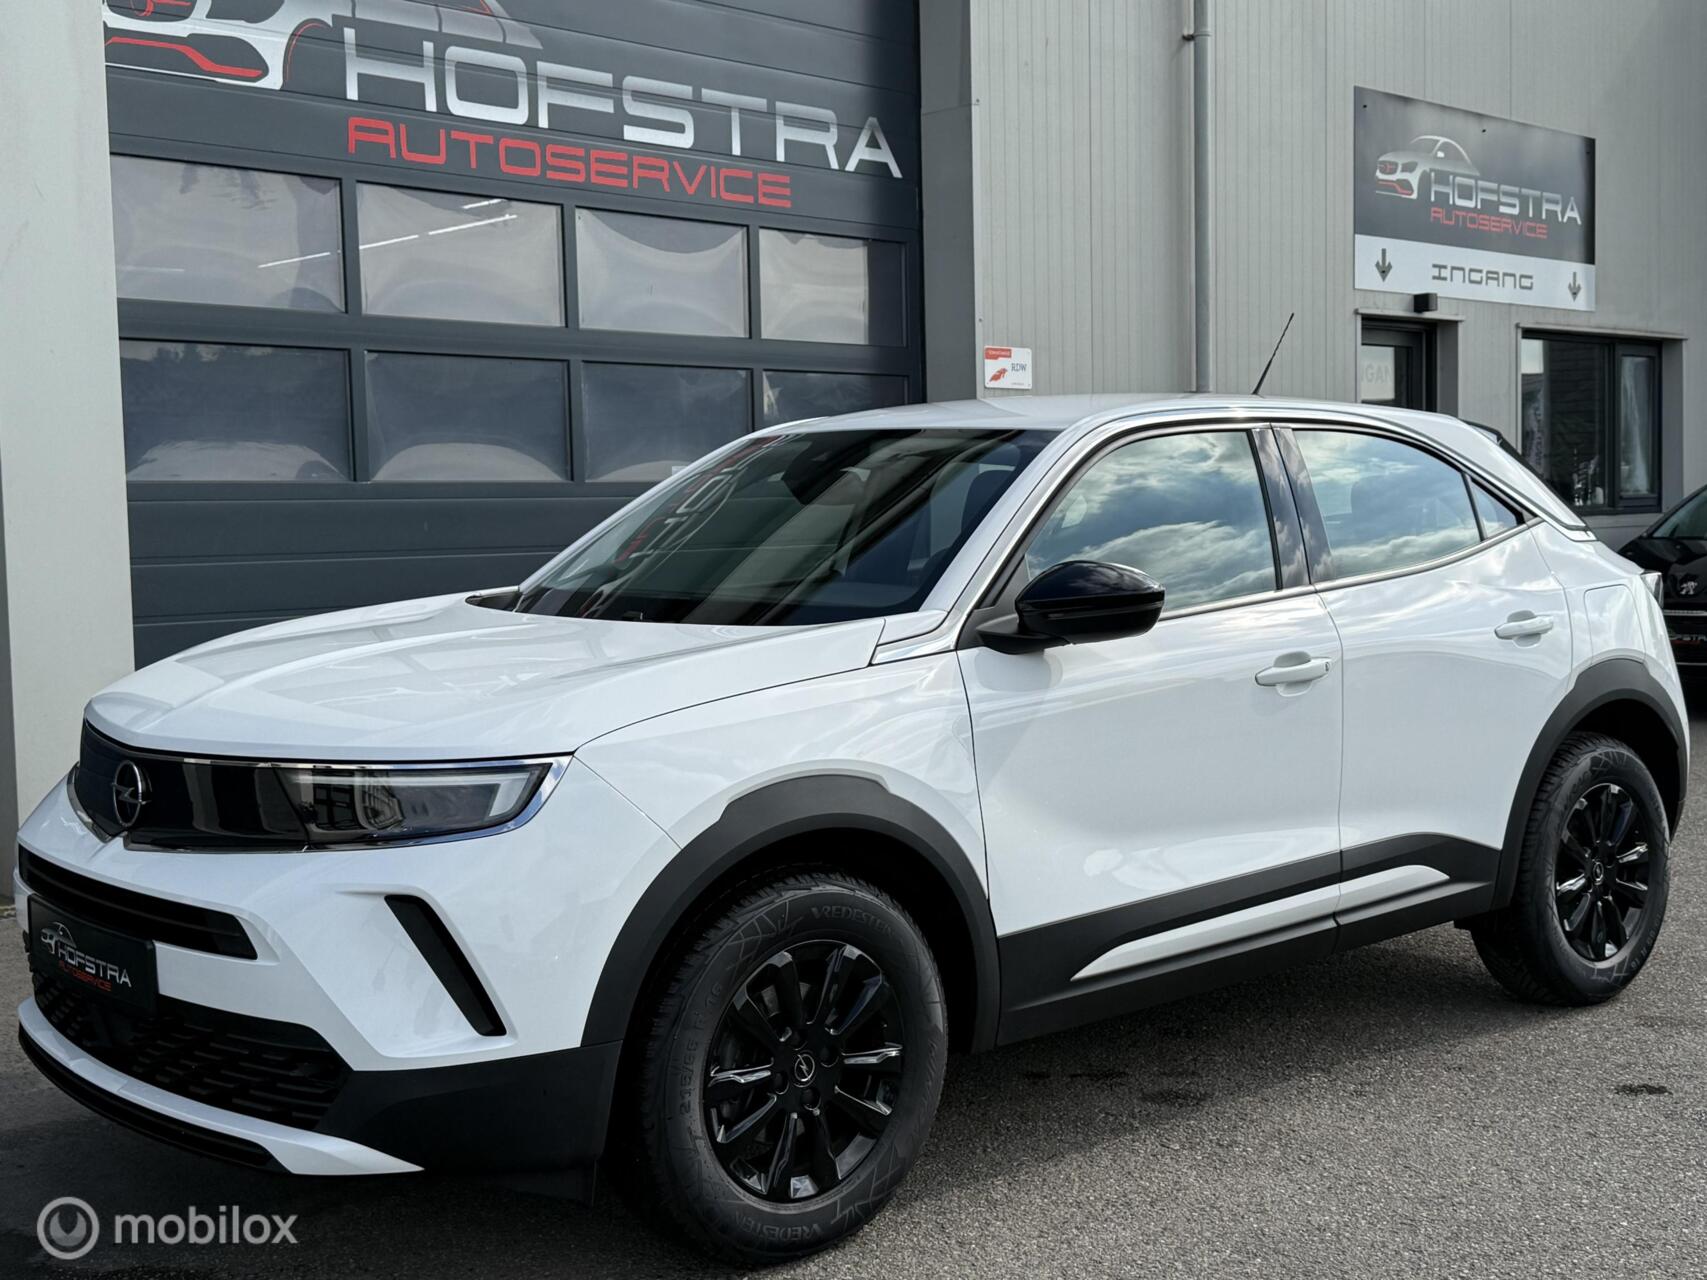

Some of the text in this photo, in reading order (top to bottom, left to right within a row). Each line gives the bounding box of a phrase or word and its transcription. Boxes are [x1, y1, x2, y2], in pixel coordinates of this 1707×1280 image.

[343, 27, 904, 179] HOFSTRA
[347, 116, 792, 208] AUTOSERVICE
[1430, 171, 1582, 225] HOFSTRA
[1430, 207, 1548, 239] AUTOSERVICE
[1431, 263, 1534, 291] INGANG
[58, 941, 132, 988] HOFSTRA
